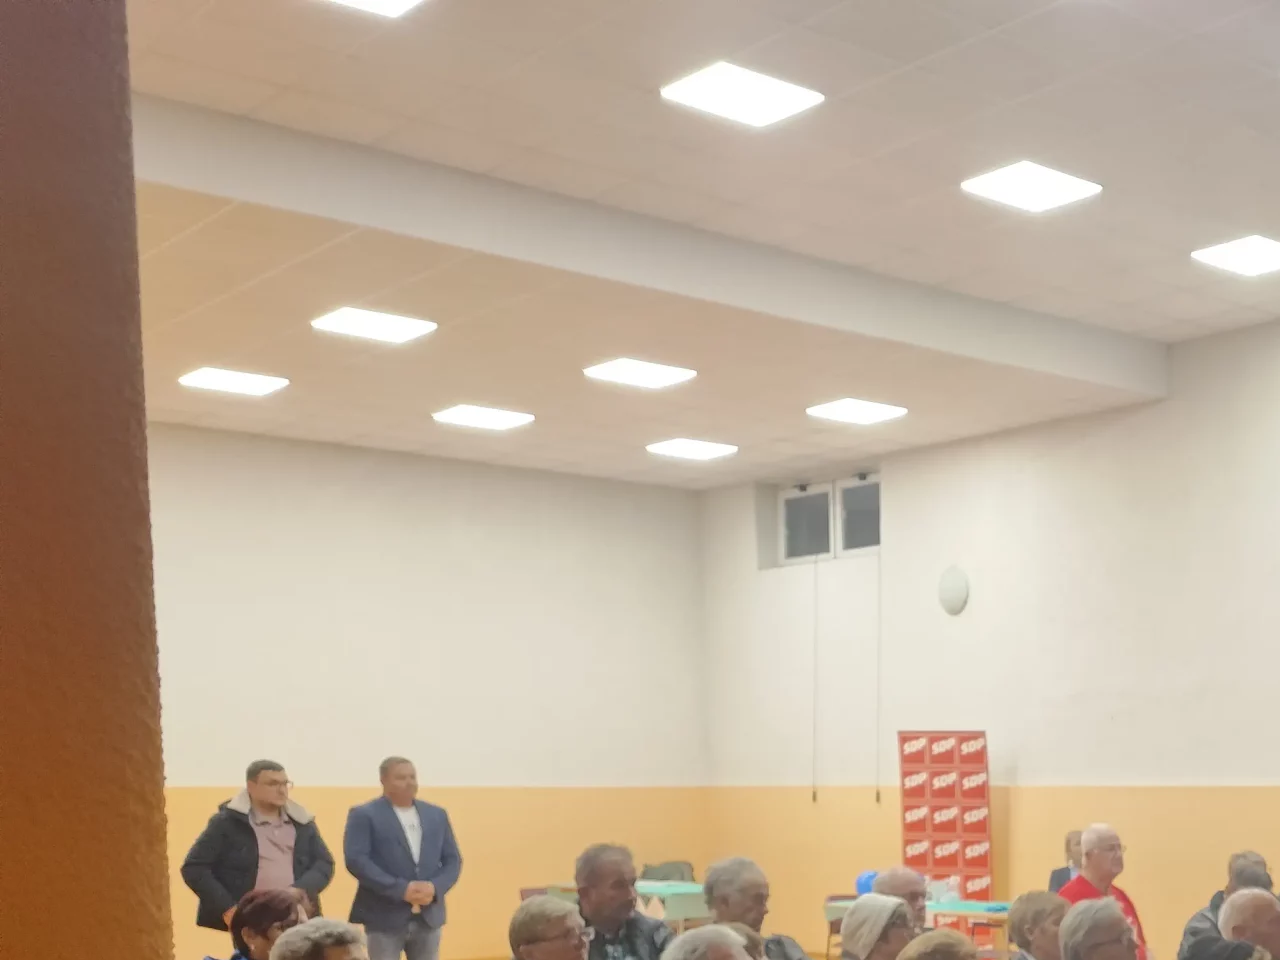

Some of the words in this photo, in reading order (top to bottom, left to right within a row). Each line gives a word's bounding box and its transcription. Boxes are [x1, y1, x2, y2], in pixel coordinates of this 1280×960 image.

[903, 736, 926, 755] SDP
[931, 736, 956, 755] SDP
[960, 737, 985, 755] SDP
[903, 771, 927, 789] SDP
[931, 771, 957, 790] SDP
[962, 771, 987, 790] SDP
[904, 805, 928, 823] SDP
[933, 805, 958, 824] SDP
[963, 806, 988, 825] SDP
[905, 839, 929, 858] SDP
[934, 840, 959, 859] SDP
[965, 840, 990, 859] SDP
[966, 875, 991, 893] SDP
